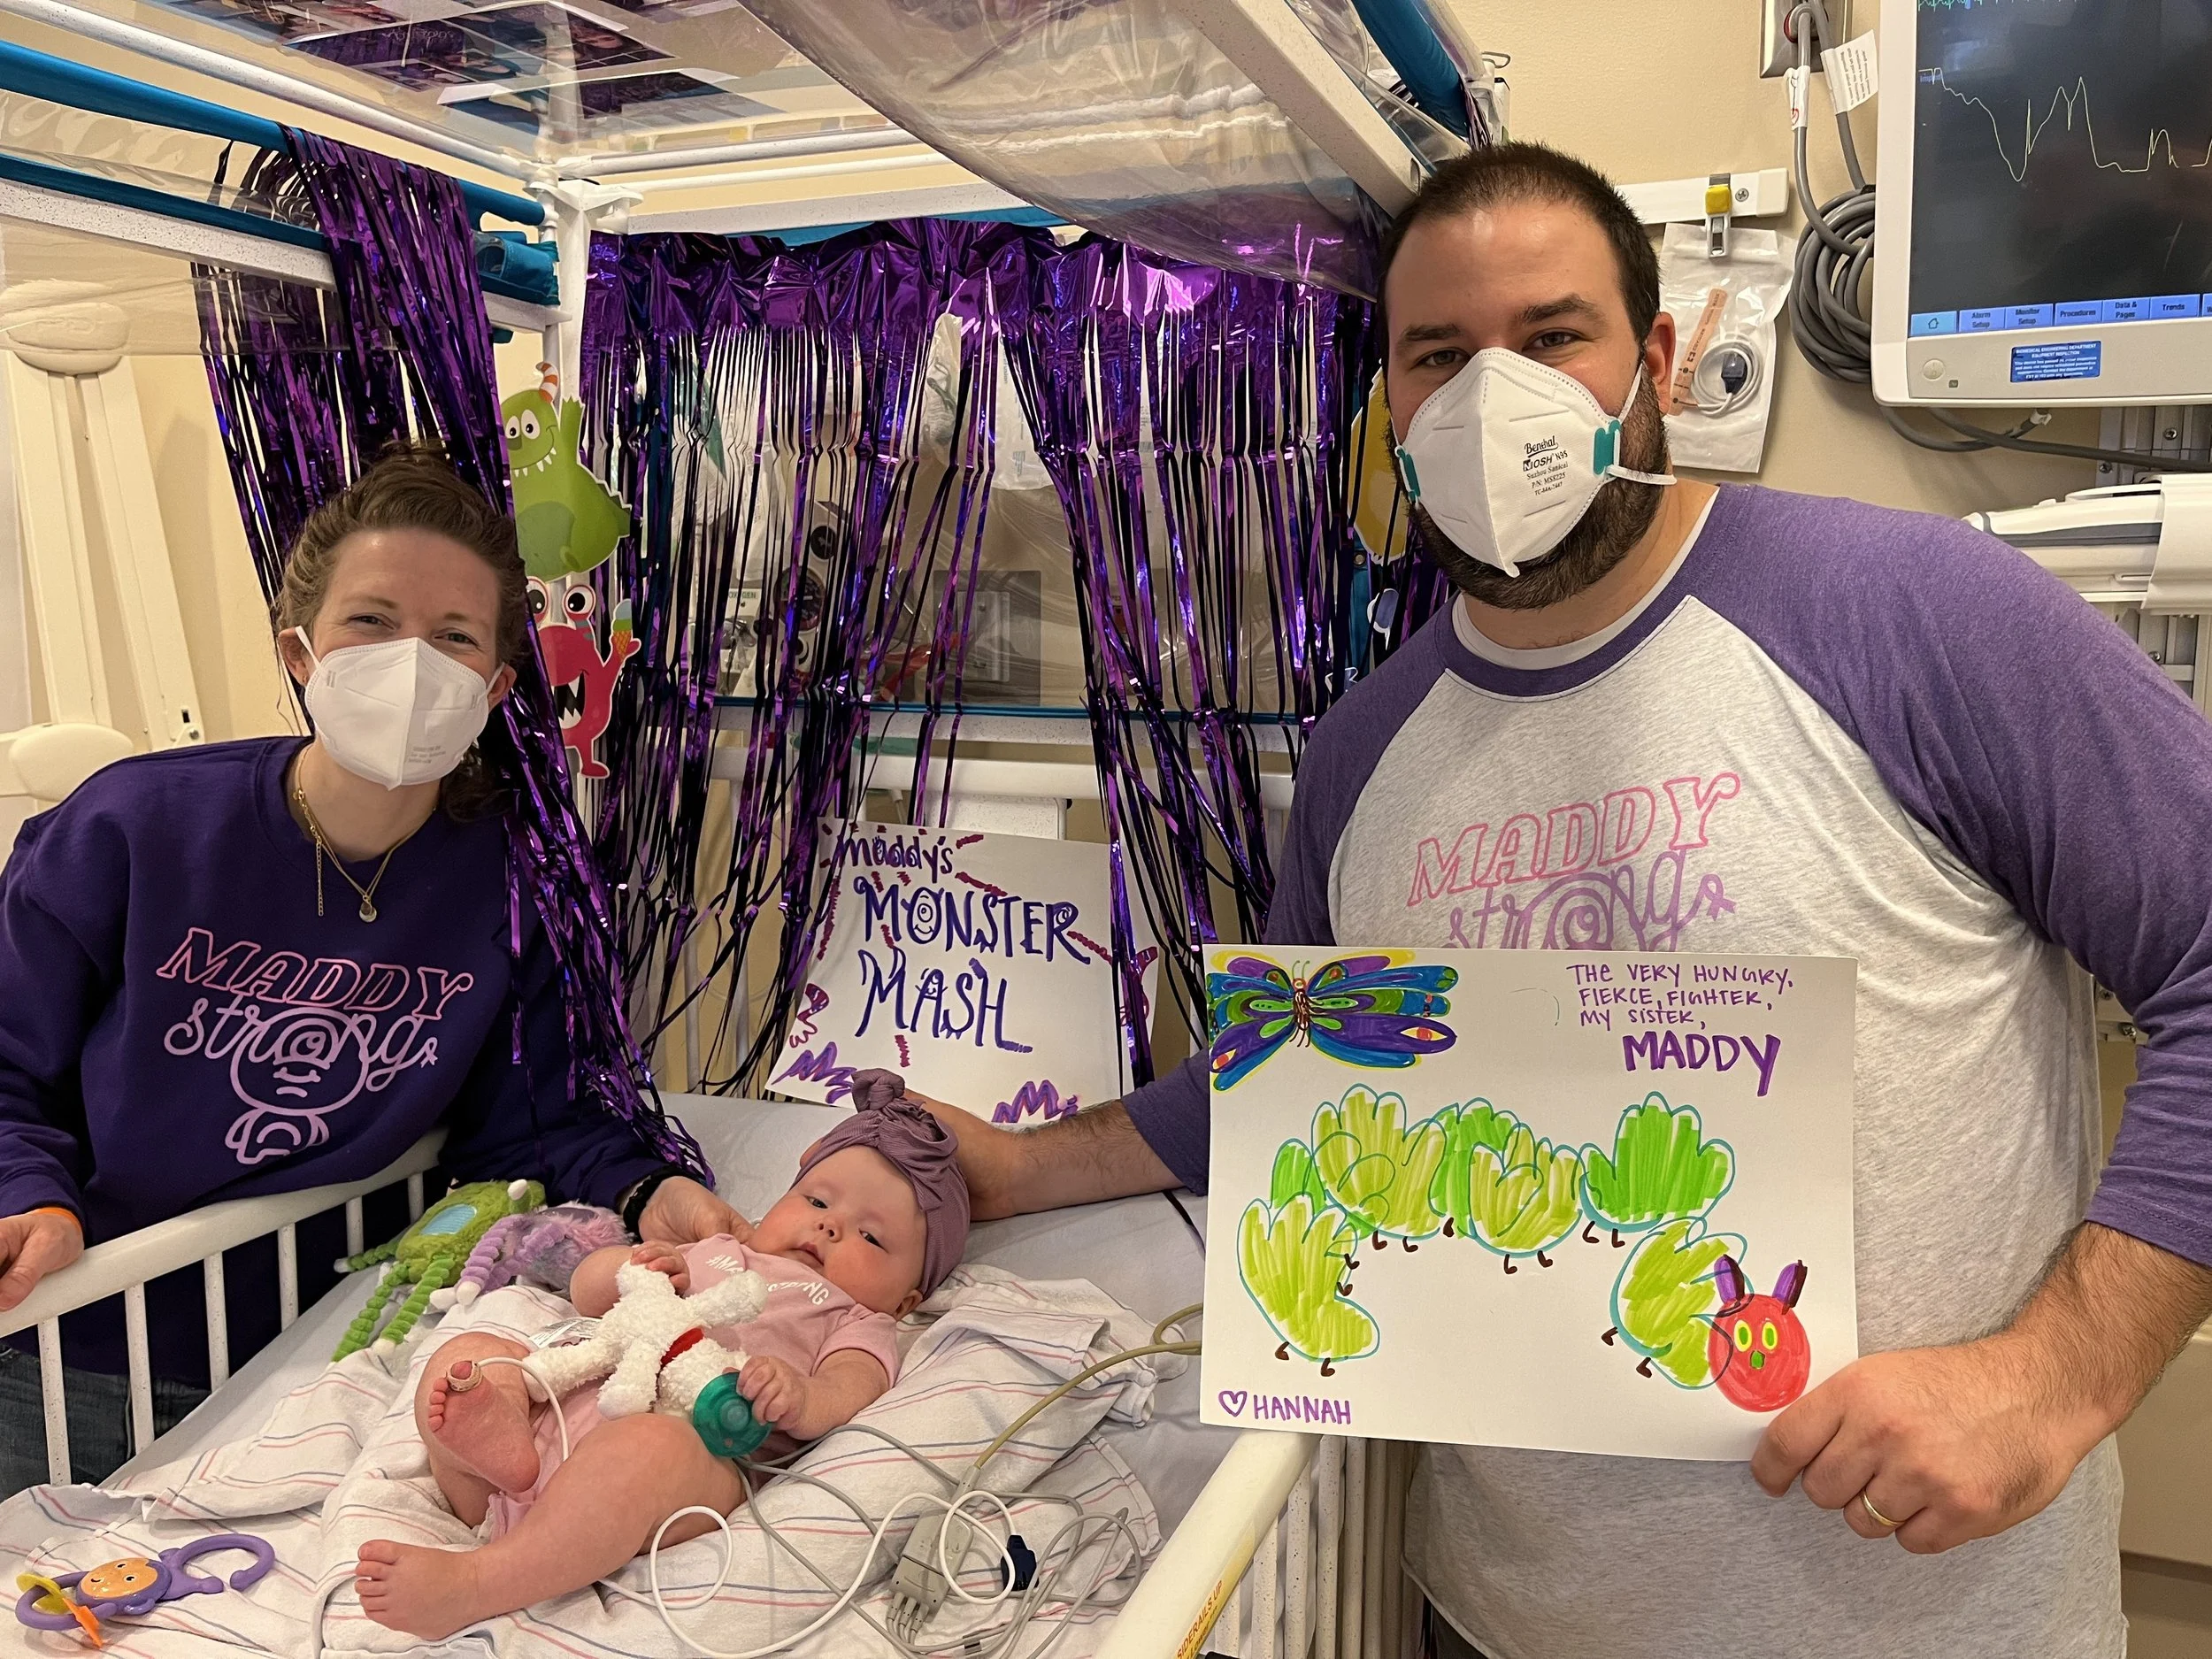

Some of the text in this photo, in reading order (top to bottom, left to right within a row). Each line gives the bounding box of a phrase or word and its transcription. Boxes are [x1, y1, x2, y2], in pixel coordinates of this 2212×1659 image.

[1523, 456, 1552, 472] NIOSH
[1407, 772, 1740, 907] MADDY
[853, 876, 1091, 964] MONSTER
[156, 926, 474, 1021] MADDY
[854, 946, 1033, 1053] MASH
[1626, 964, 1680, 987] VERY
[1622, 1030, 1781, 1097] MADDY
[1253, 1394, 1352, 1425] HANNAH
[1213, 1579, 1222, 1601] UP
